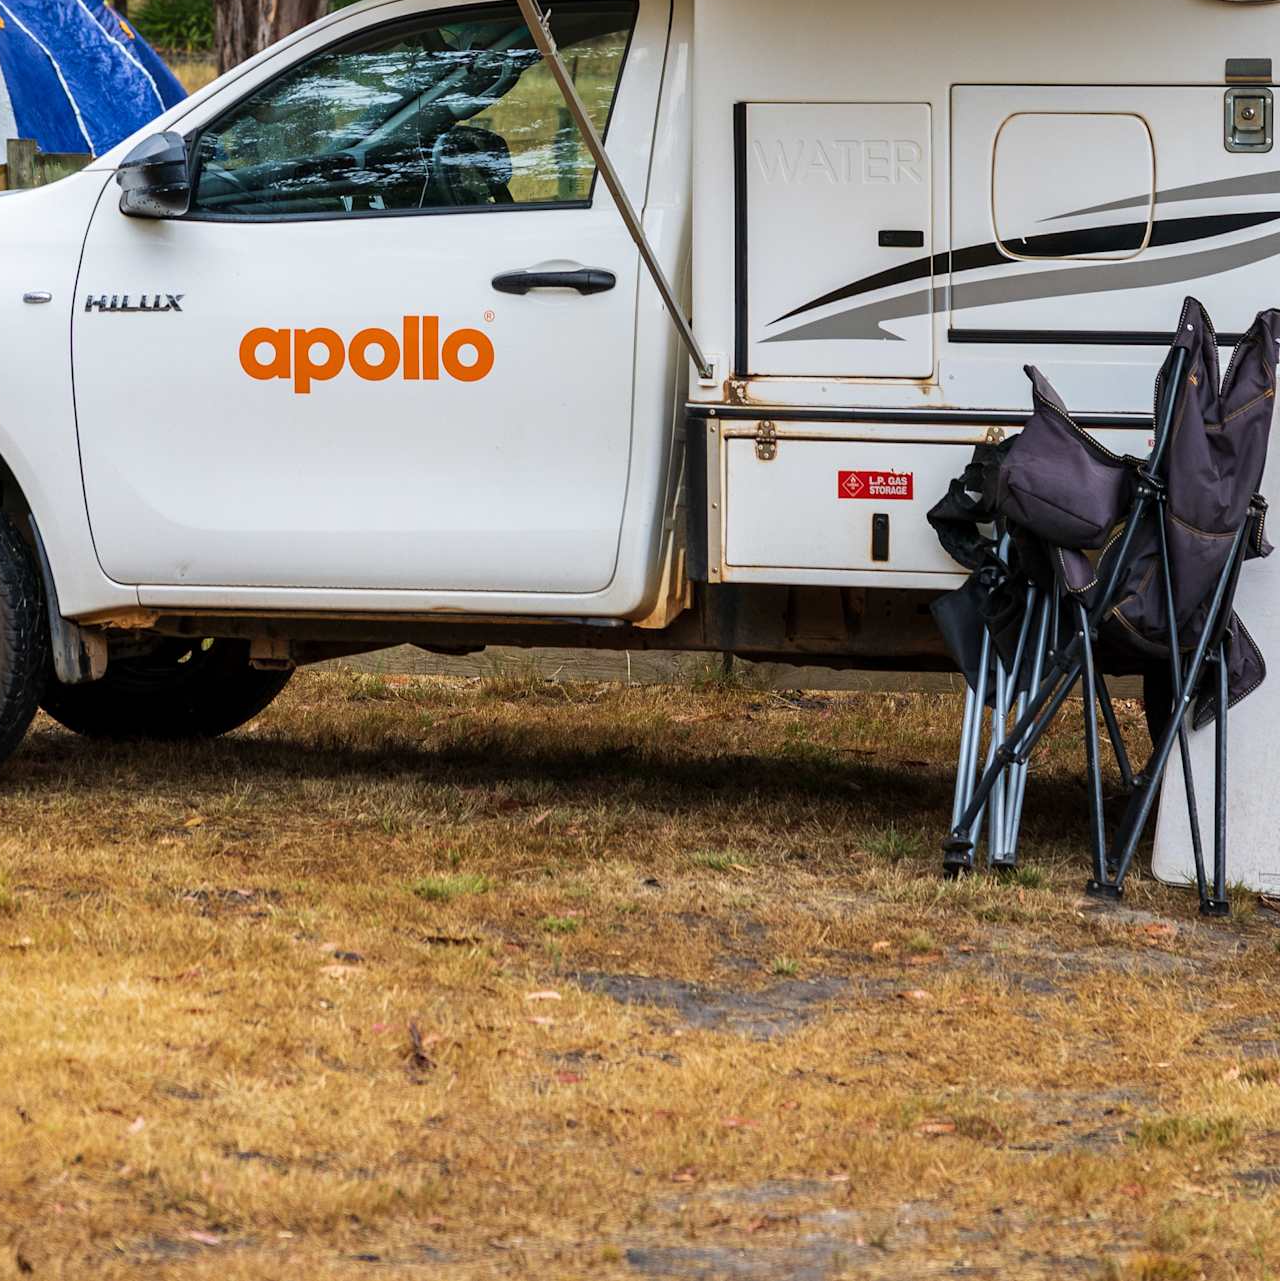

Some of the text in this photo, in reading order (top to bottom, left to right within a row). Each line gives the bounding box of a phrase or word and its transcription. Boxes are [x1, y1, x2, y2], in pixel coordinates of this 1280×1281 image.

[752, 138, 922, 185] WATER
[84, 292, 186, 313] HILUX
[239, 315, 495, 394] apollo
[869, 476, 908, 485] L.P. GAS
[869, 486, 908, 495] STORAGE
